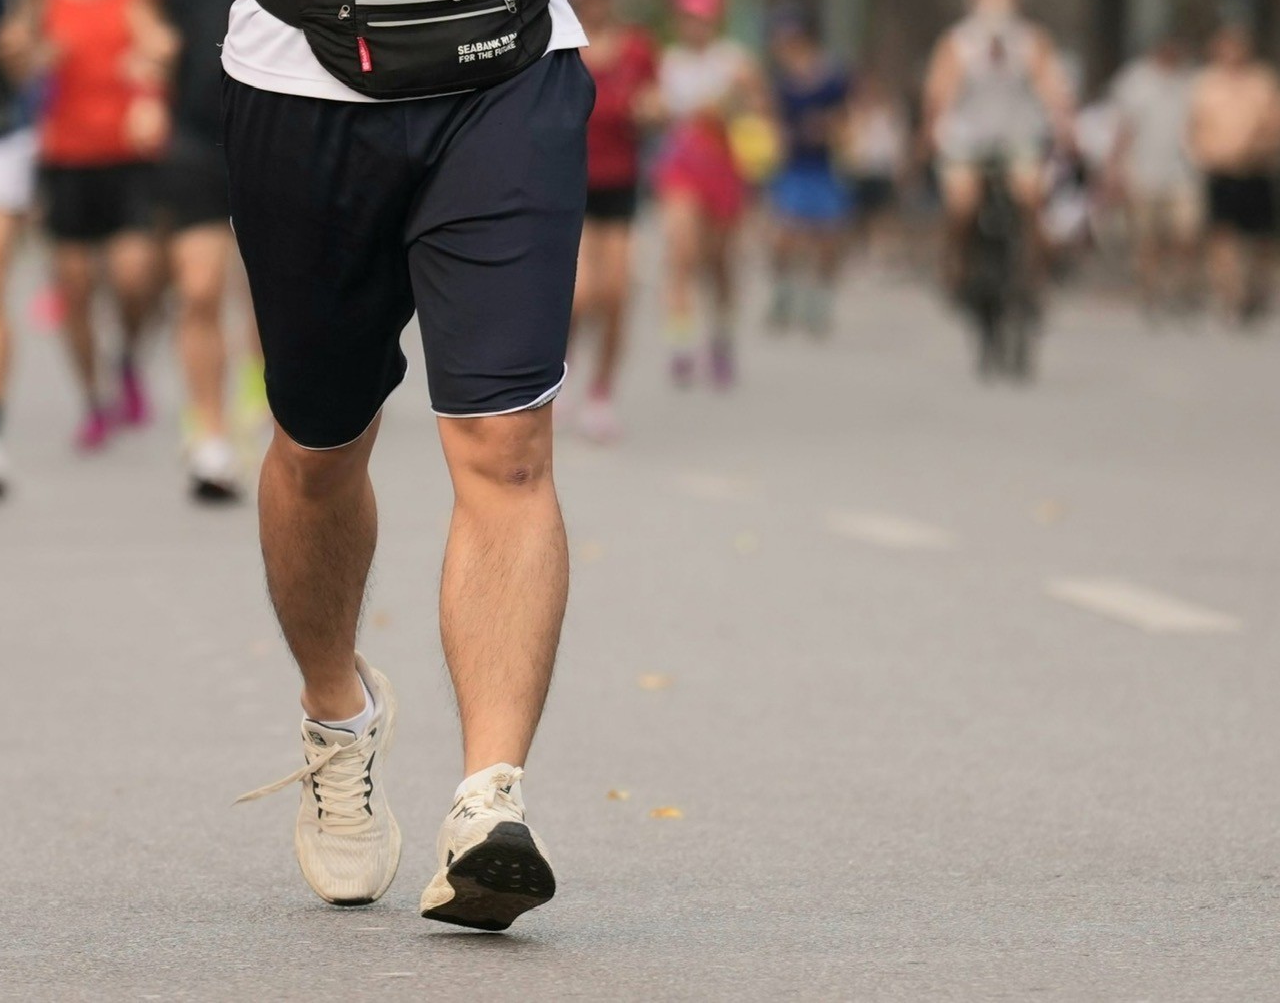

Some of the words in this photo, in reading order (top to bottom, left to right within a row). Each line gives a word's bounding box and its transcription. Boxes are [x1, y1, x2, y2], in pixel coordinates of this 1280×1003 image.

[458, 39, 501, 55] SEABANK
[459, 54, 475, 63] FOR
[477, 50, 494, 60] THE
